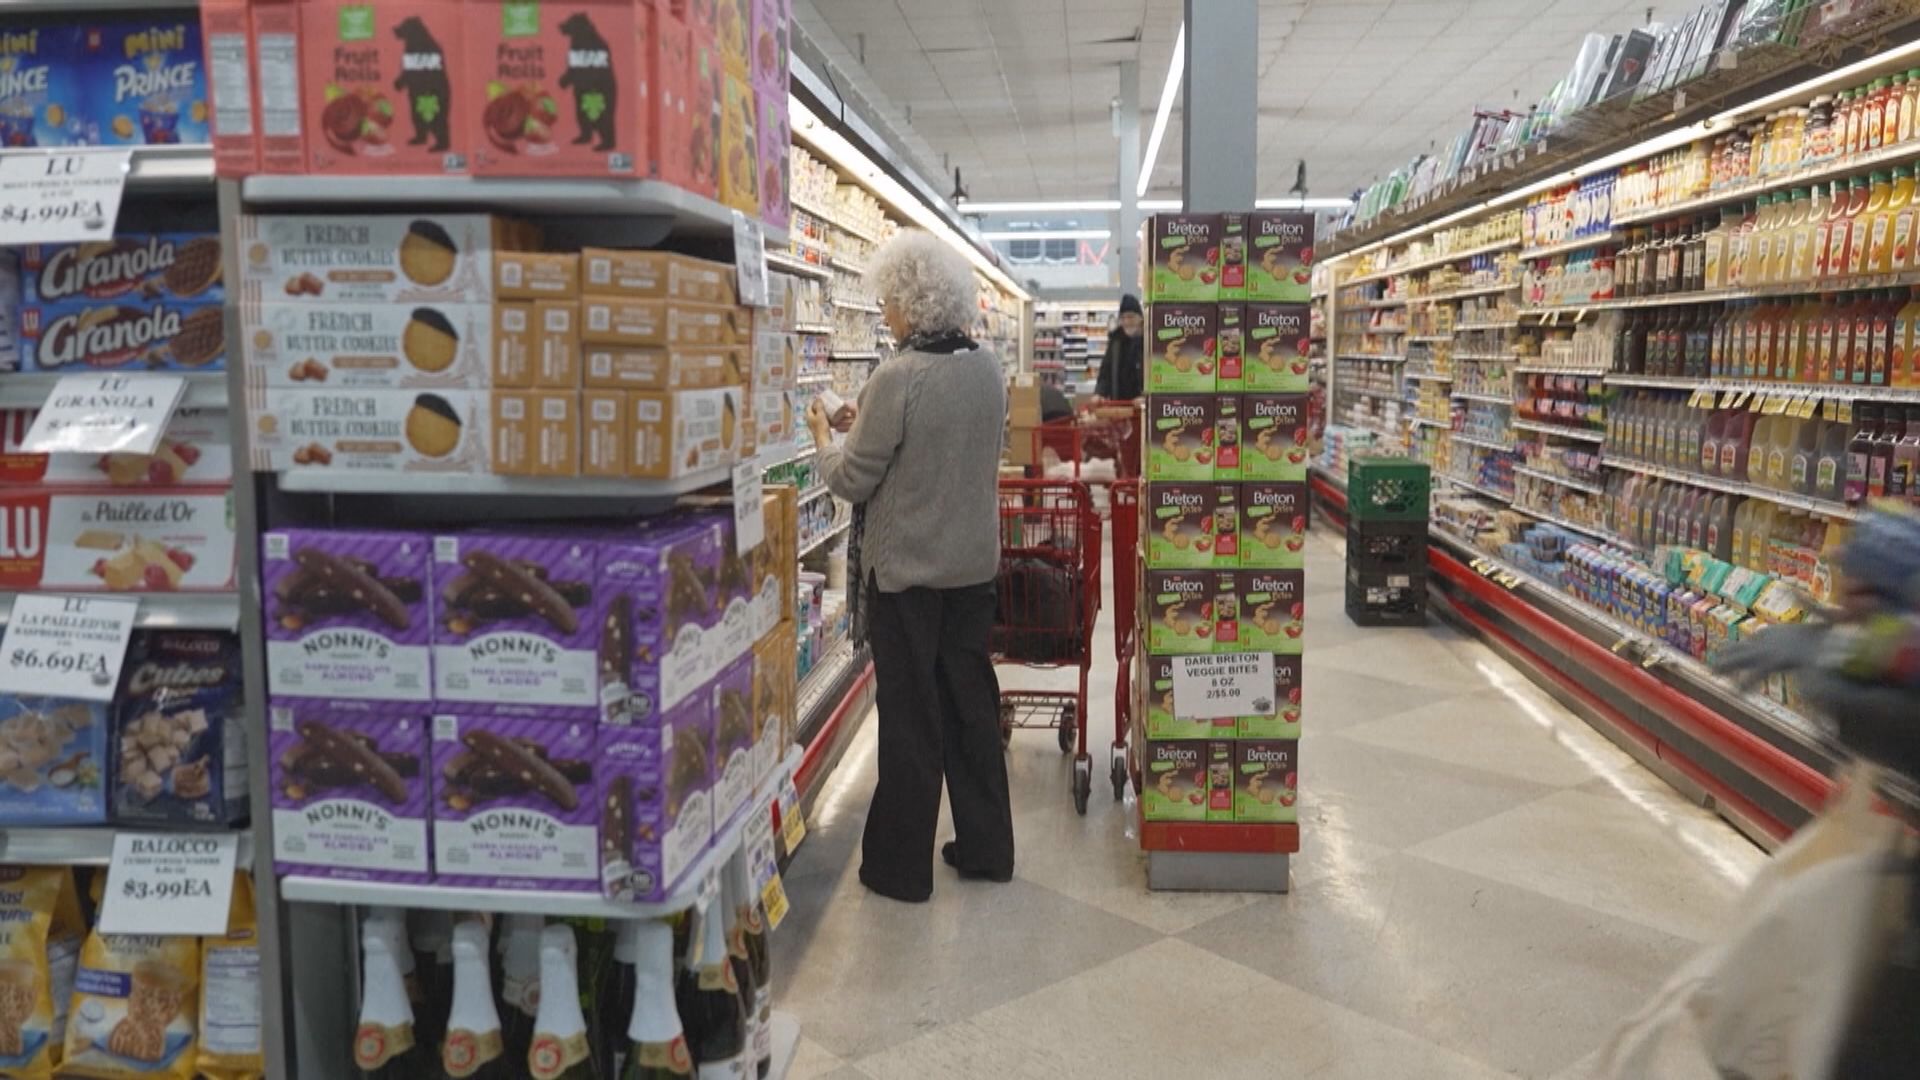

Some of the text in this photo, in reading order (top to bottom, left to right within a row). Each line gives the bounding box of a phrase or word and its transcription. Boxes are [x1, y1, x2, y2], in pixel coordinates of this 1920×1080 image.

[403, 52, 442, 70] BEAR
[568, 49, 609, 67] BEAR
[113, 61, 196, 102] PRINCE
[46, 157, 84, 175] LU
[305, 224, 371, 245] FRENCH
[1168, 222, 1209, 235] Breton
[1262, 222, 1304, 235] Breton
[282, 249, 394, 266] BUTTER COOKIES
[40, 236, 177, 299] Granola
[307, 312, 373, 332] FRENCH
[1164, 314, 1206, 327] Breton
[1258, 314, 1300, 326] Breton
[38, 304, 182, 368] Granola
[286, 336, 397, 351] BUTTER COOKIES
[54, 396, 155, 409] GRANOLA
[312, 397, 377, 417] FRENCH
[1163, 404, 1204, 416] Breton
[1256, 403, 1297, 416] Breton
[291, 420, 401, 436] BUTTER COOKIES
[1162, 493, 1203, 505] Breton
[1254, 492, 1295, 504] Breton
[1163, 579, 1204, 592] Breton
[1252, 578, 1294, 591] Breton
[304, 632, 390, 658] NONNI'S
[470, 636, 557, 664] NONNI'S
[10, 649, 108, 674] $6.69EA
[1184, 653, 1259, 666] DARE BRETON
[1186, 664, 1258, 677] VEGGIE BITES
[1220, 677, 1235, 687] OZ
[1206, 688, 1240, 699] 2/$5.00
[1157, 748, 1197, 760] Breton
[1247, 748, 1288, 761] Breton
[306, 802, 388, 831] NONNI'S
[470, 813, 559, 838] NONNI'S
[131, 838, 219, 854] BALOCCO
[122, 878, 213, 899] $3.99EA
